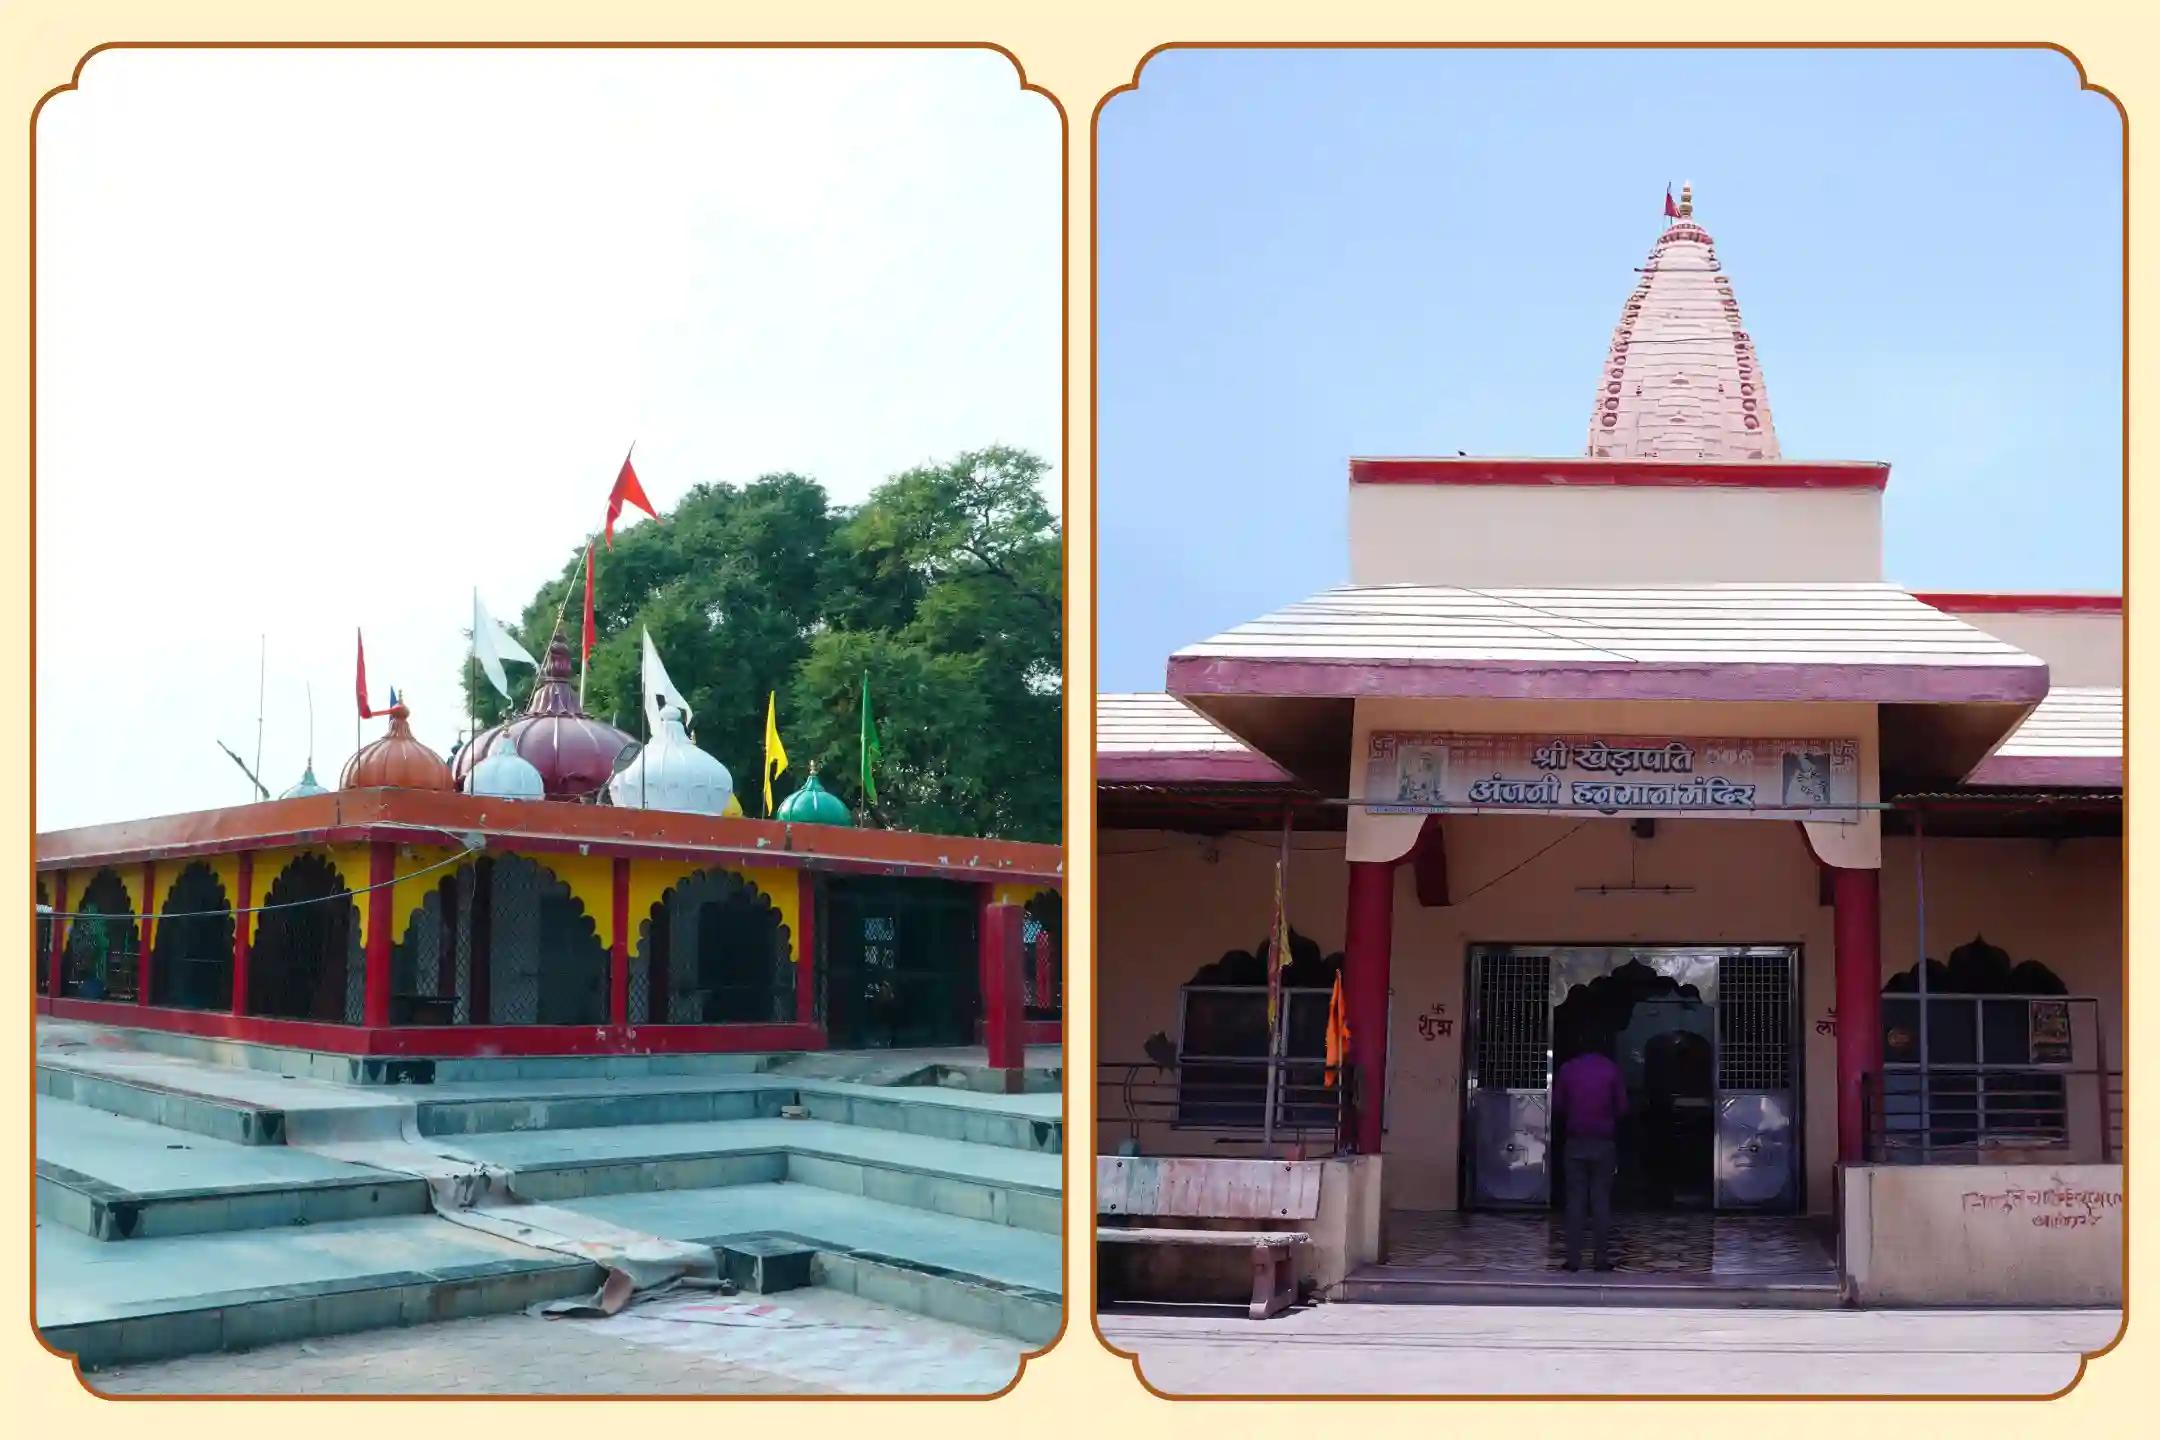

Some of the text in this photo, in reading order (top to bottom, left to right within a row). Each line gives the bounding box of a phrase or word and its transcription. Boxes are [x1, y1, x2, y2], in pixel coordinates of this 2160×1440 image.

[1531, 738, 1568, 770] श्री
[1573, 740, 1695, 775] खेड़ापति
[1468, 772, 1561, 803] अंजनी
[1418, 1014, 1453, 1041] शुभ
[1815, 1020, 1837, 1037] ला
